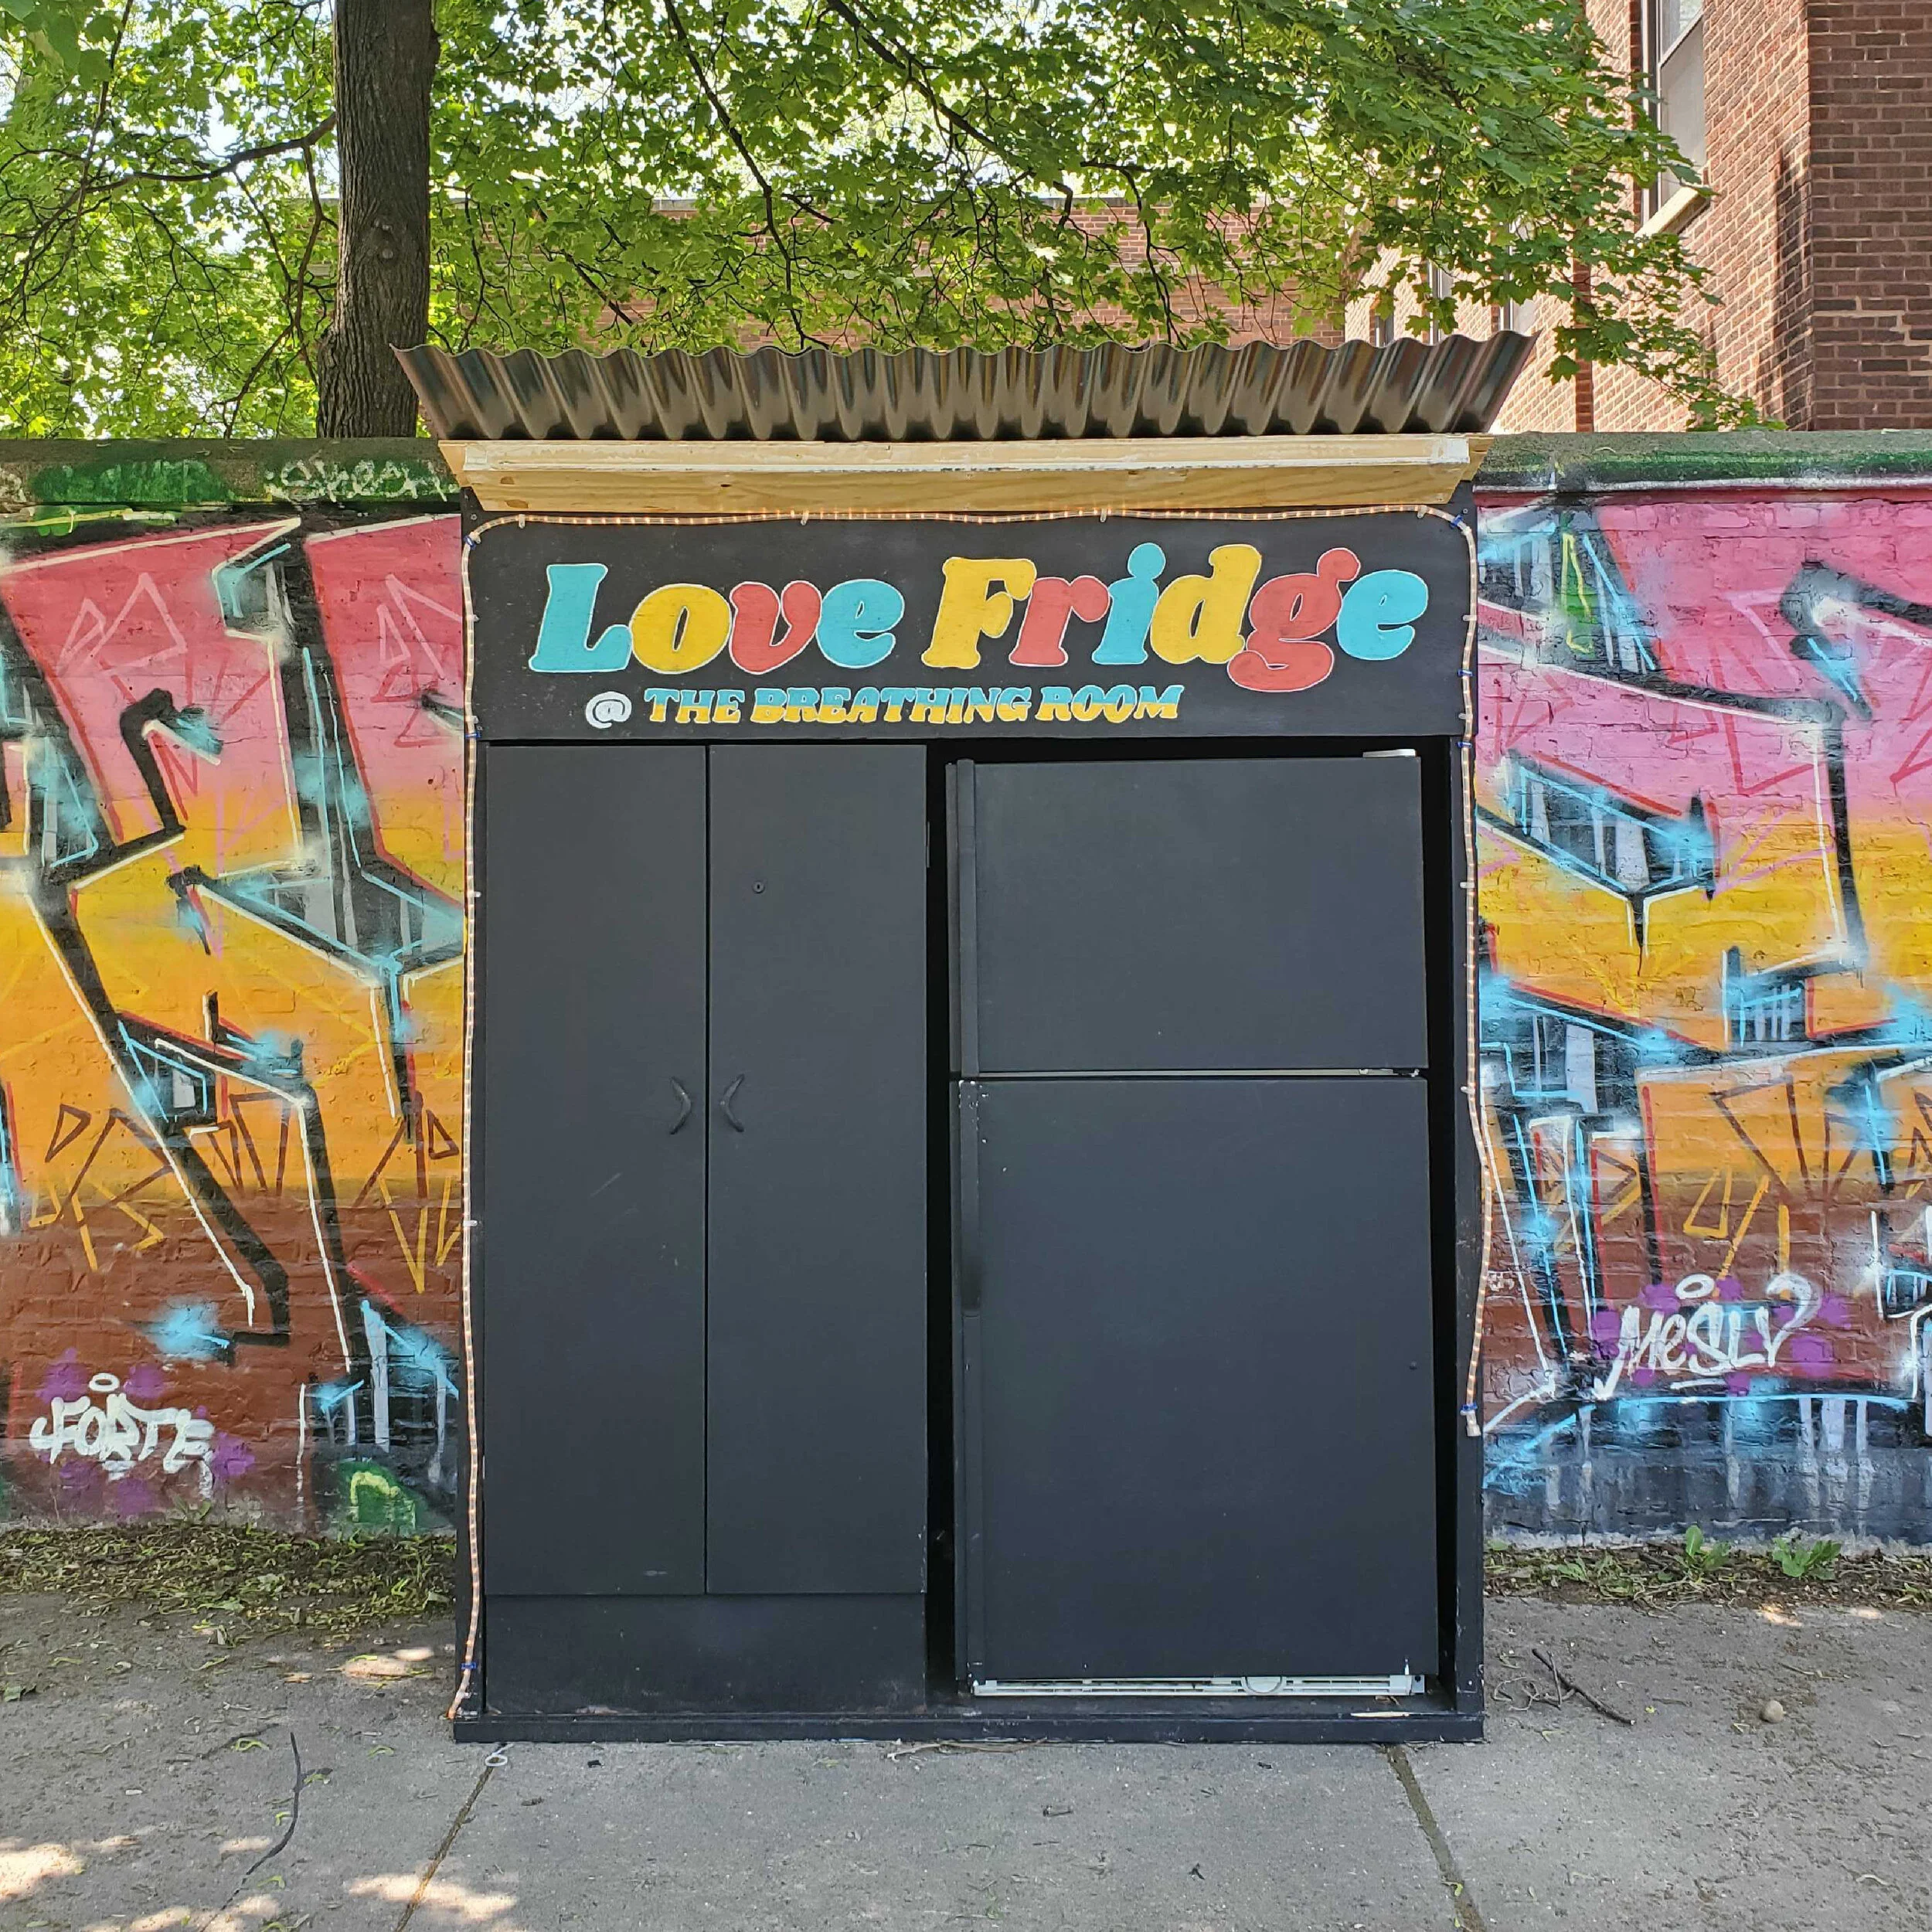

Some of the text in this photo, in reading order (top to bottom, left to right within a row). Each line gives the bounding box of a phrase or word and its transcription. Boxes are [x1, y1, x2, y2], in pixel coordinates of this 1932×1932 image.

[529, 543, 1428, 692] Love Fridge
[586, 685, 1185, 729] @ THE BREATHING ROOM
